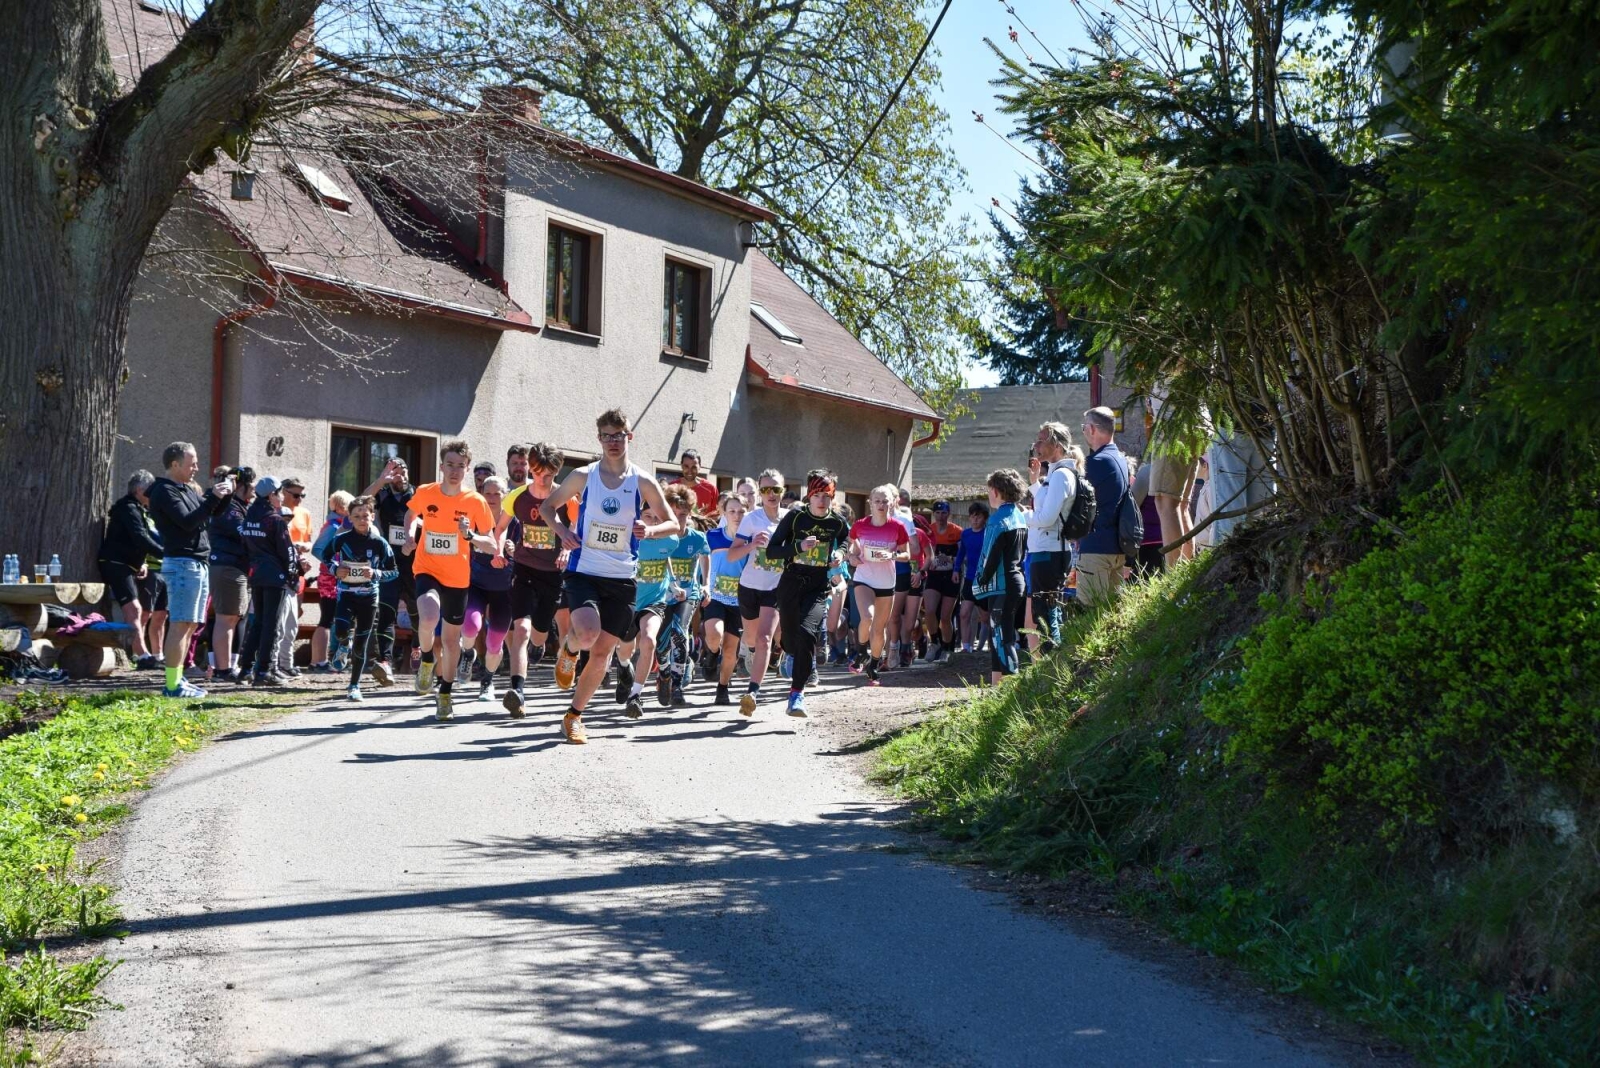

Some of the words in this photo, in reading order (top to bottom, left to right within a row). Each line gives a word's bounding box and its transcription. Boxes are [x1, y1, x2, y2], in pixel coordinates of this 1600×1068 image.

[266, 436, 285, 457] 62
[529, 531, 549, 543] 115
[596, 530, 618, 544] 188
[431, 538, 450, 549] 180
[806, 548, 819, 559] 14
[643, 565, 664, 577] 215
[722, 580, 739, 591] 179
